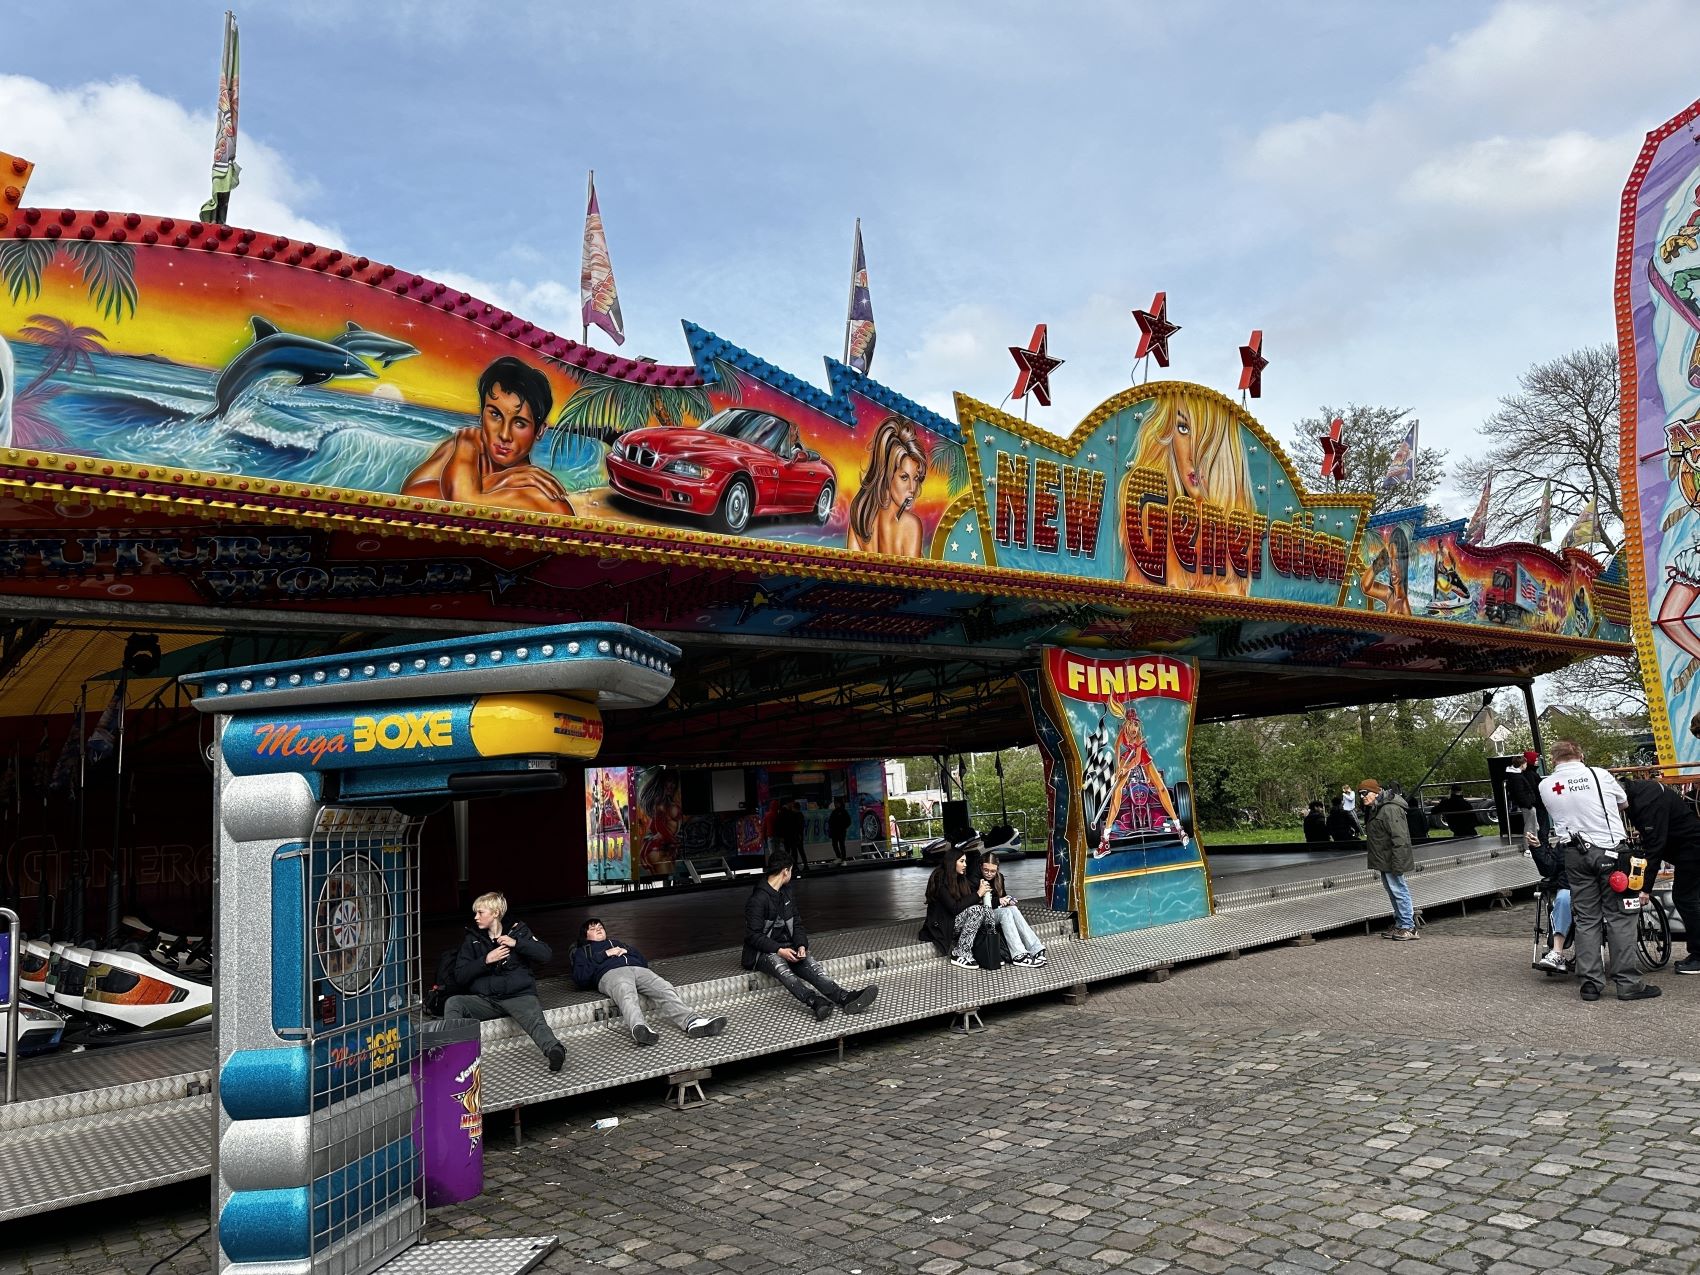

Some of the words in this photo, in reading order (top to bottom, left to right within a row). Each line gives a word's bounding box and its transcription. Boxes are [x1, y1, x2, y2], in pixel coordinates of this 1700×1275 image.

[995, 450, 1107, 560] NEW
[1126, 466, 1349, 585] Generation
[201, 564, 473, 599] WORLD
[1067, 660, 1181, 695] FINISH
[255, 723, 349, 766] Mega
[354, 710, 453, 752] BOXE
[1567, 777, 1588, 785] Rode
[1568, 783, 1590, 792] Kruis
[6, 834, 213, 898] GENERA
